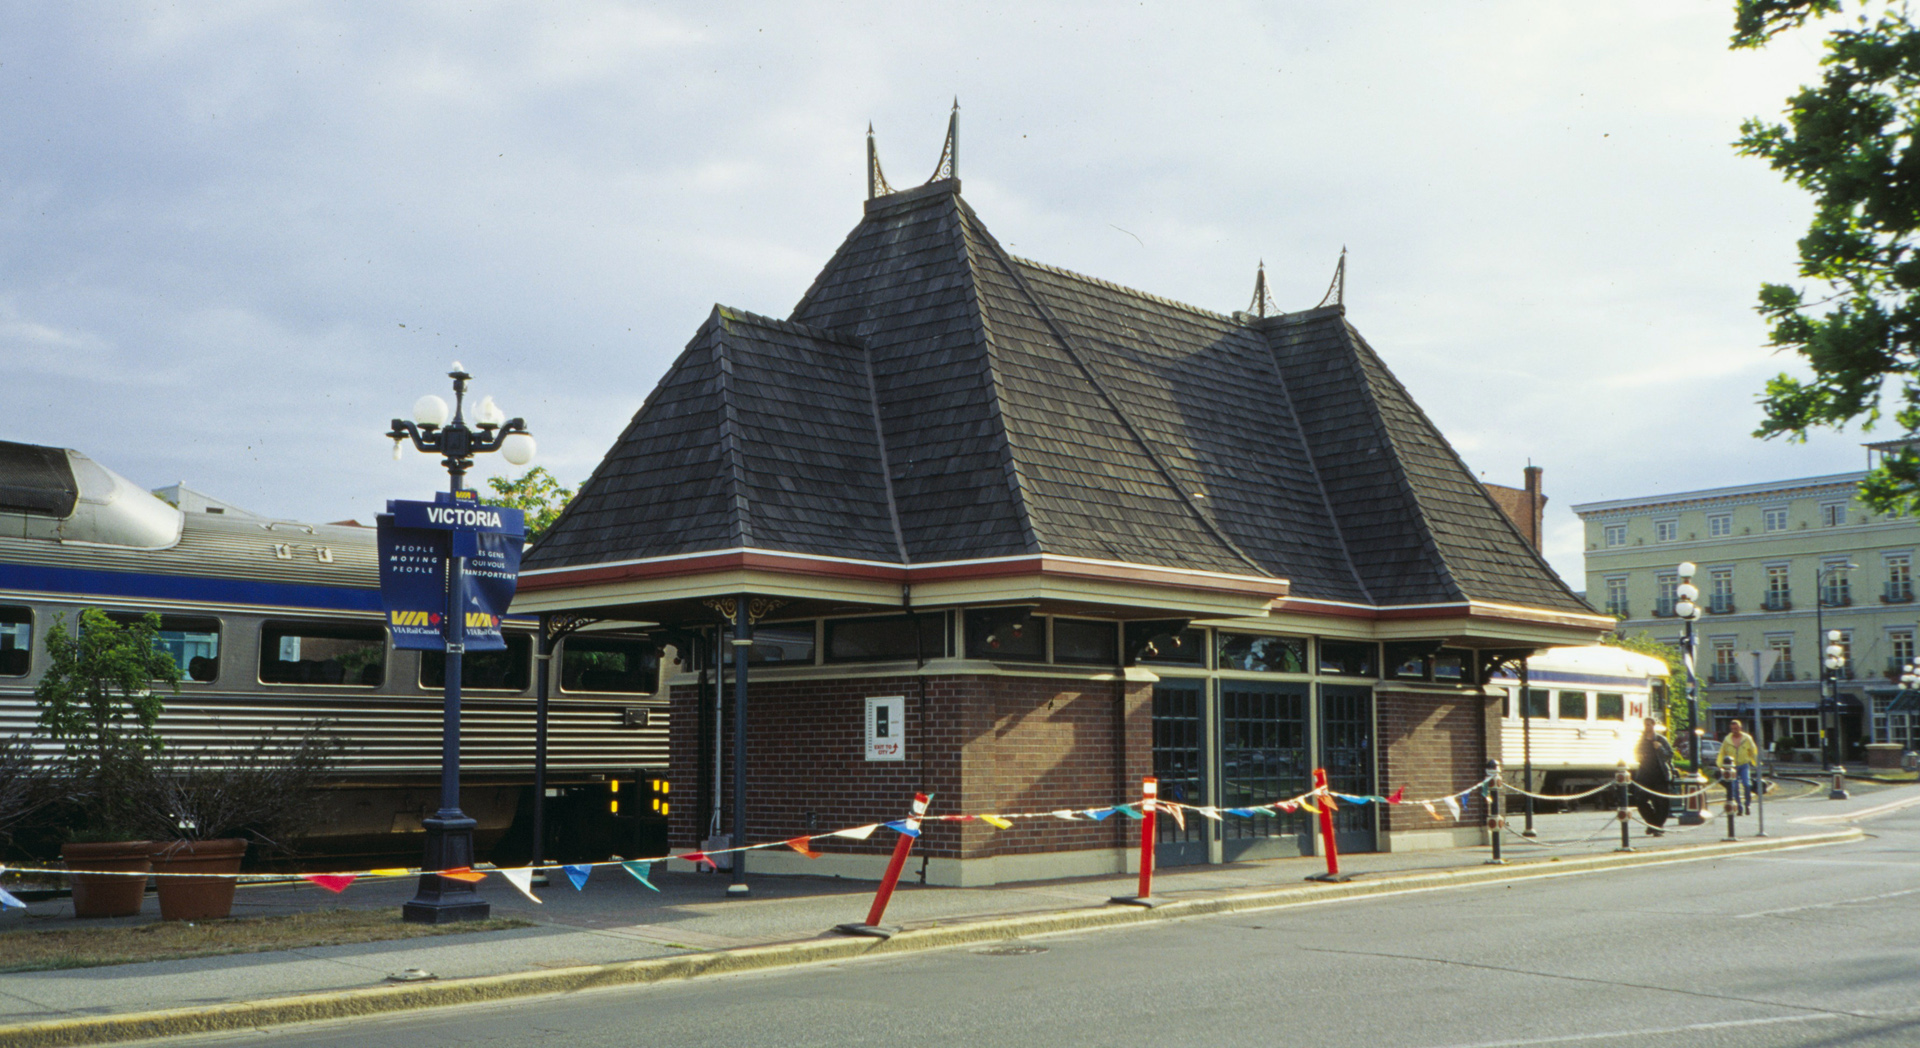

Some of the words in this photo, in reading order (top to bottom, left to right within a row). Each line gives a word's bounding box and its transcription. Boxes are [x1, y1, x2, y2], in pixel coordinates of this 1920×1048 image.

[455, 491, 471, 499] VIA
[427, 507, 502, 528] VICTORIA
[395, 545, 434, 553] PEOPLE
[476, 549, 486, 557] ES
[487, 551, 505, 559] GENS
[390, 555, 438, 564] MOVING
[472, 559, 486, 567] QUI
[487, 561, 505, 569] VOUS
[393, 565, 433, 574] PEOPLE
[391, 610, 429, 626] VIA
[465, 612, 493, 628] VIA
[393, 626, 407, 634] VIA
[406, 627, 418, 635] Rail
